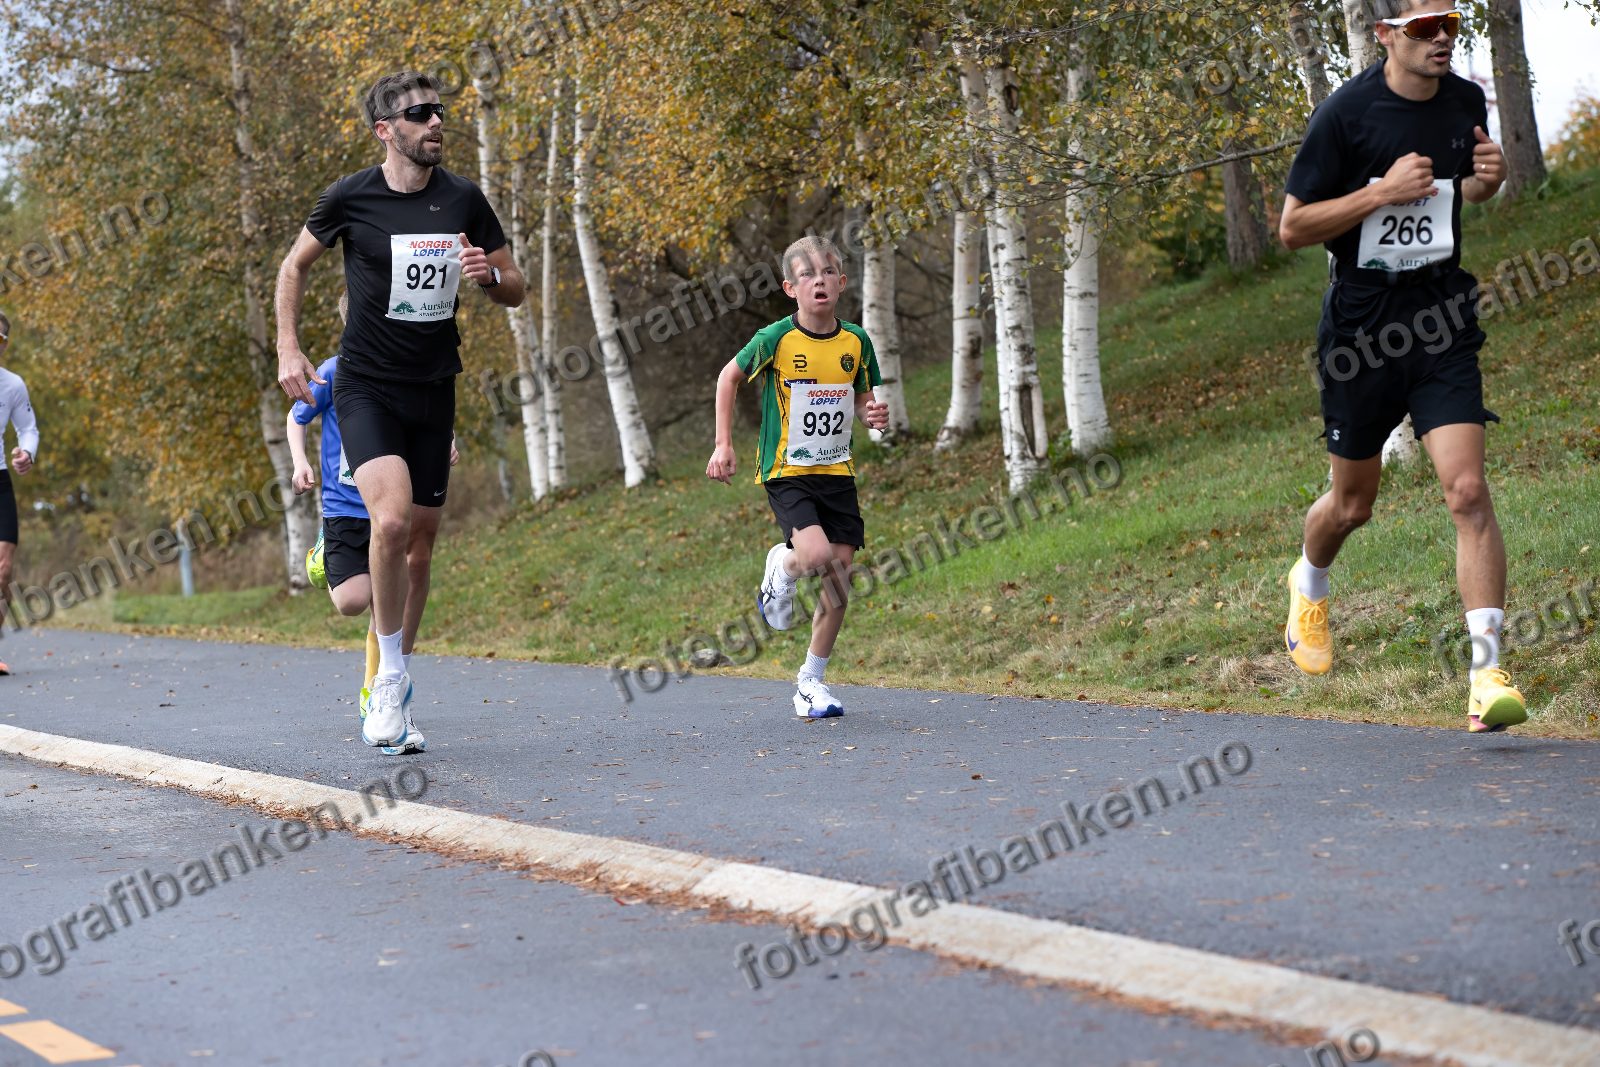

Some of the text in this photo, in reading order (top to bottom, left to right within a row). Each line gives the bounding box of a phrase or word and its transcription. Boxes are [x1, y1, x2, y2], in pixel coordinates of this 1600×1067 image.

[1378, 215, 1433, 246] 266
[408, 240, 453, 249] NORGES
[413, 249, 447, 257] LØPET
[406, 263, 447, 290] 921
[807, 389, 848, 398] NORGES
[810, 397, 842, 406] LØPET
[803, 410, 844, 437] 932
